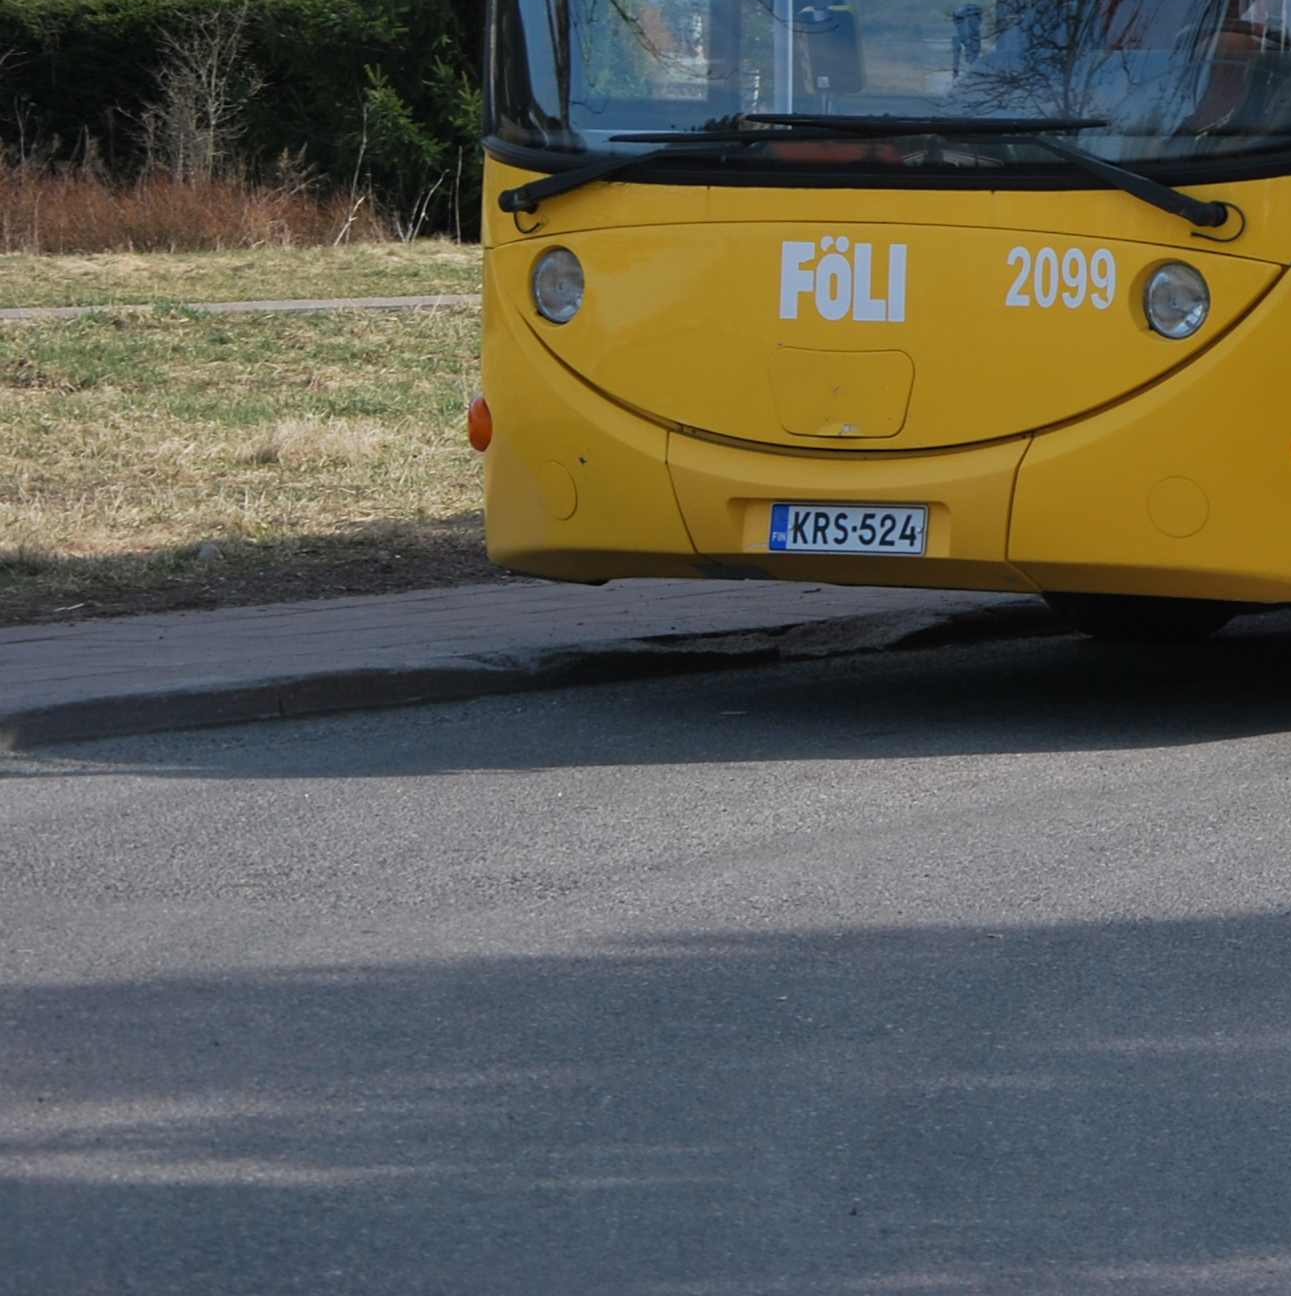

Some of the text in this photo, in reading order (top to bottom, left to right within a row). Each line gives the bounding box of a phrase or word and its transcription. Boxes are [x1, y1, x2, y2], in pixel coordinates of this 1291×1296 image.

[779, 235, 907, 322] FÖLI
[1005, 246, 1116, 310] 2099
[771, 531, 787, 543] FIN
[792, 511, 917, 547] KRS-524
